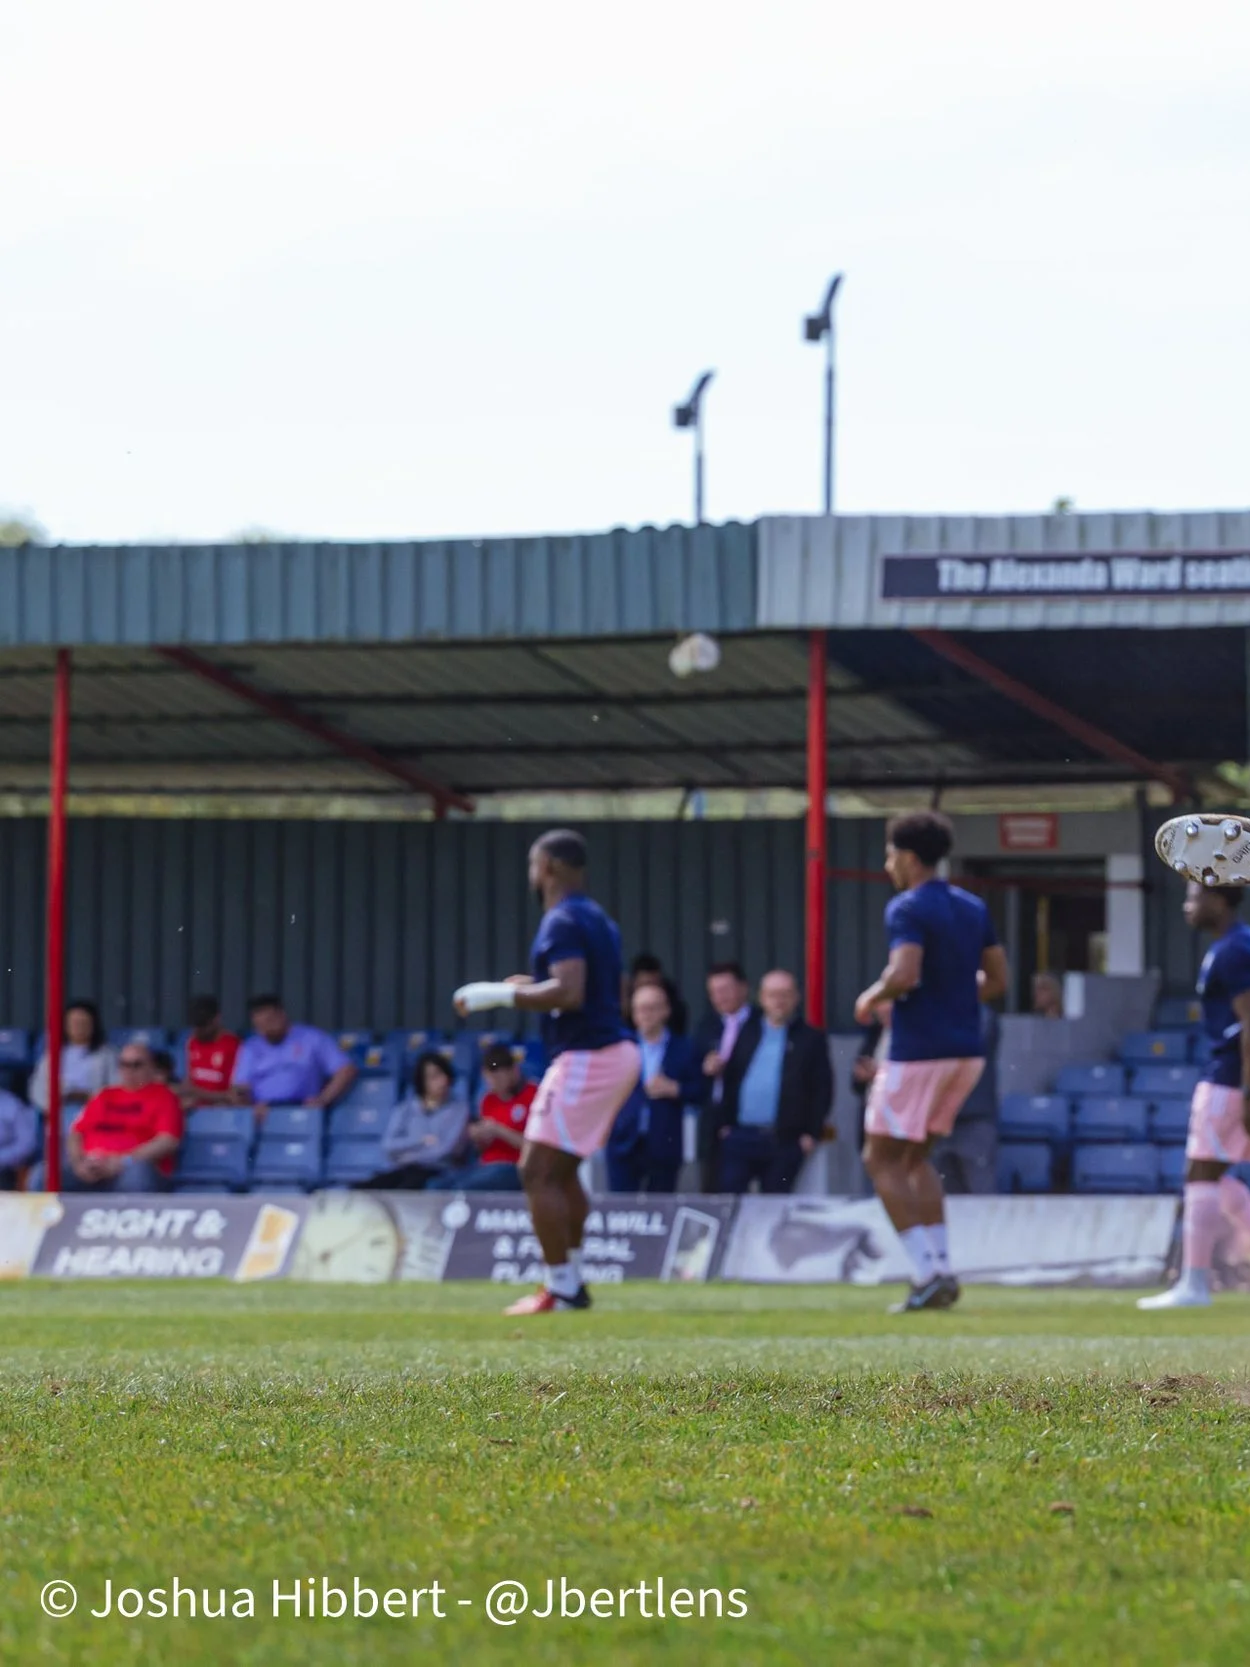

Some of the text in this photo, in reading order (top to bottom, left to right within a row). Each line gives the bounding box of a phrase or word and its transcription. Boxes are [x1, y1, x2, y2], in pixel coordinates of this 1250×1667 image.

[937, 558, 986, 592] The
[1110, 557, 1183, 591] Ward
[76, 1208, 228, 1240] SIGHT &
[606, 1209, 669, 1236] WILL
[52, 1244, 225, 1277] HEARING
[493, 1234, 514, 1260] &
